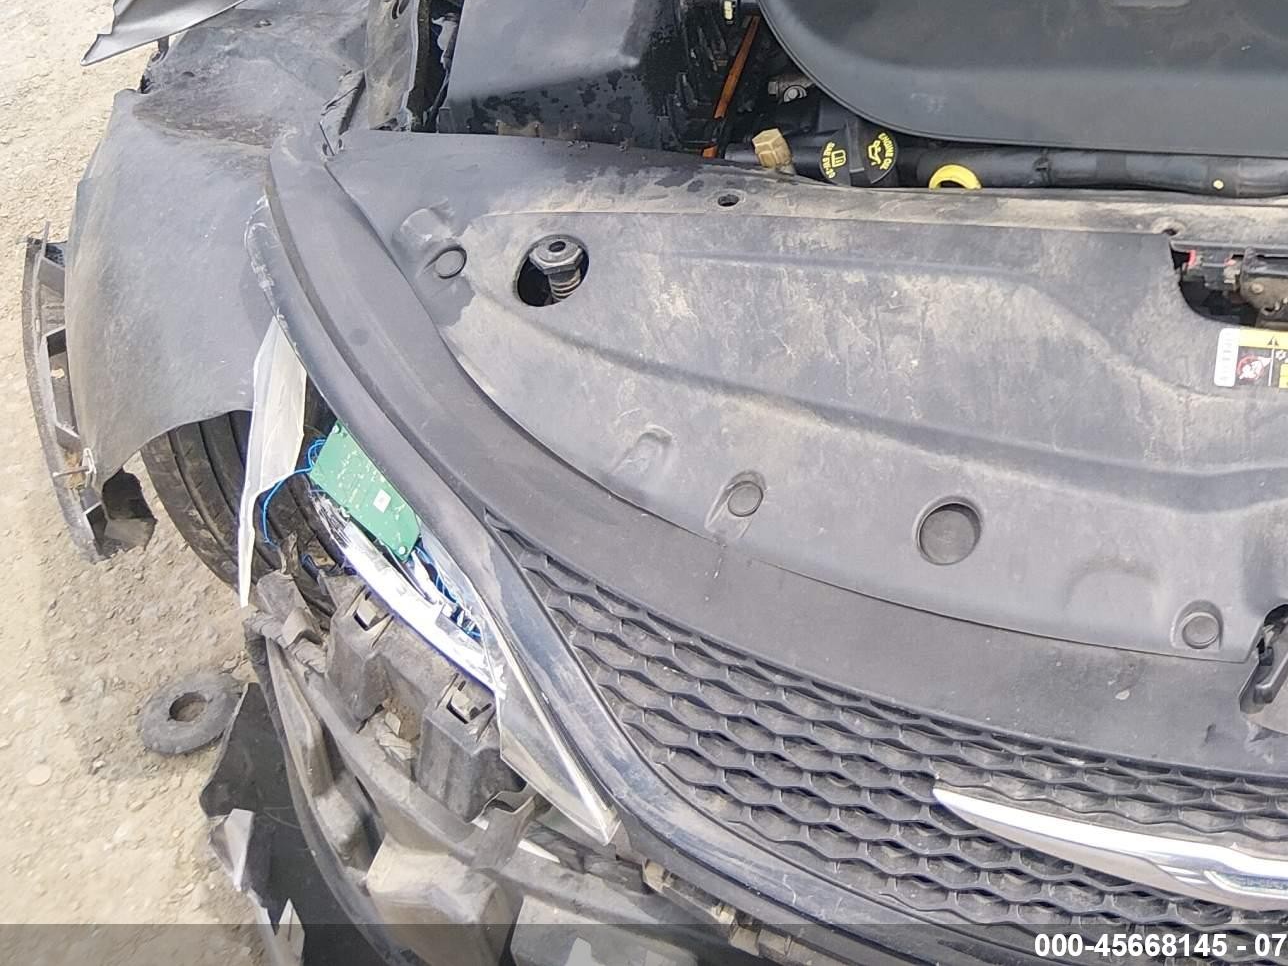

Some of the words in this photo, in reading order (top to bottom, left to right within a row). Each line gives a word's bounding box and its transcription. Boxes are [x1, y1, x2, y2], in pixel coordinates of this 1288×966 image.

[823, 141, 836, 157] SAE
[878, 132, 894, 158] ENGINE
[879, 157, 893, 171] OIL
